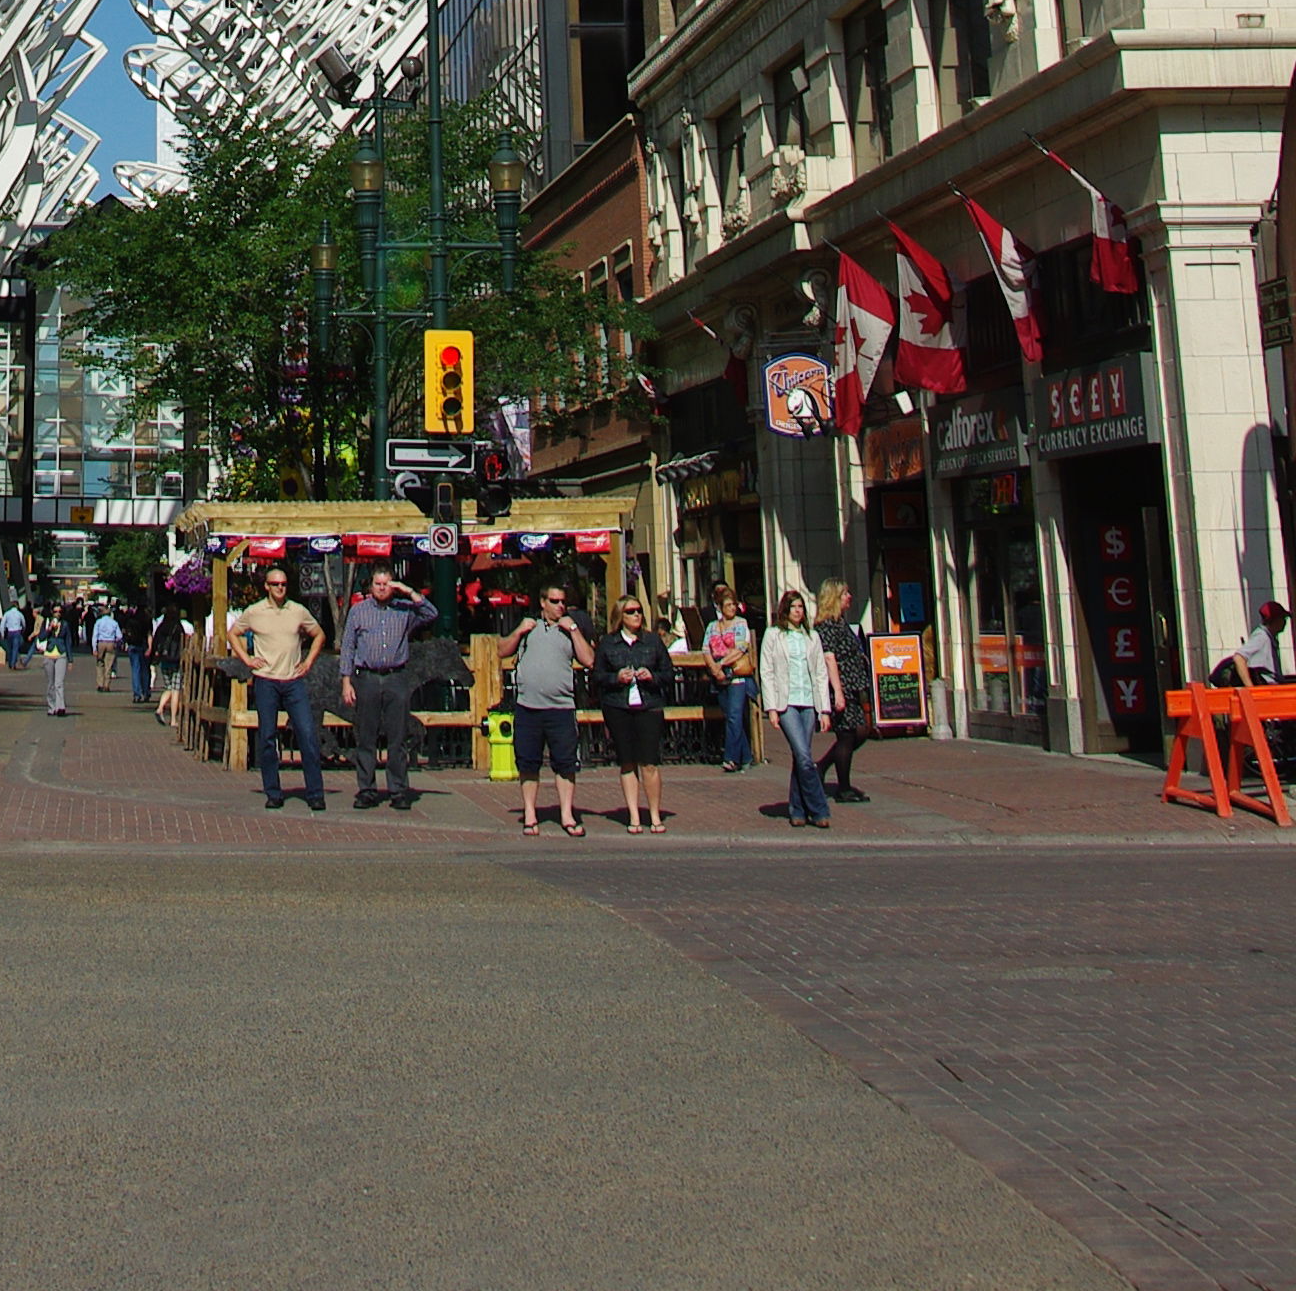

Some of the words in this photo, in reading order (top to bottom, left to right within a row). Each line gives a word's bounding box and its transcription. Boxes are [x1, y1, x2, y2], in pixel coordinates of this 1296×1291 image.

[769, 368, 824, 397] Unicorn
[937, 407, 995, 451] calforex
[1038, 425, 1088, 452] CURRENCY
[1090, 416, 1144, 443] EXCHANGE
[987, 446, 1017, 463] SERVICES
[1104, 526, 1126, 559] $
[1108, 577, 1132, 606] €
[1115, 628, 1135, 658] £
[1116, 680, 1138, 709] ¥
